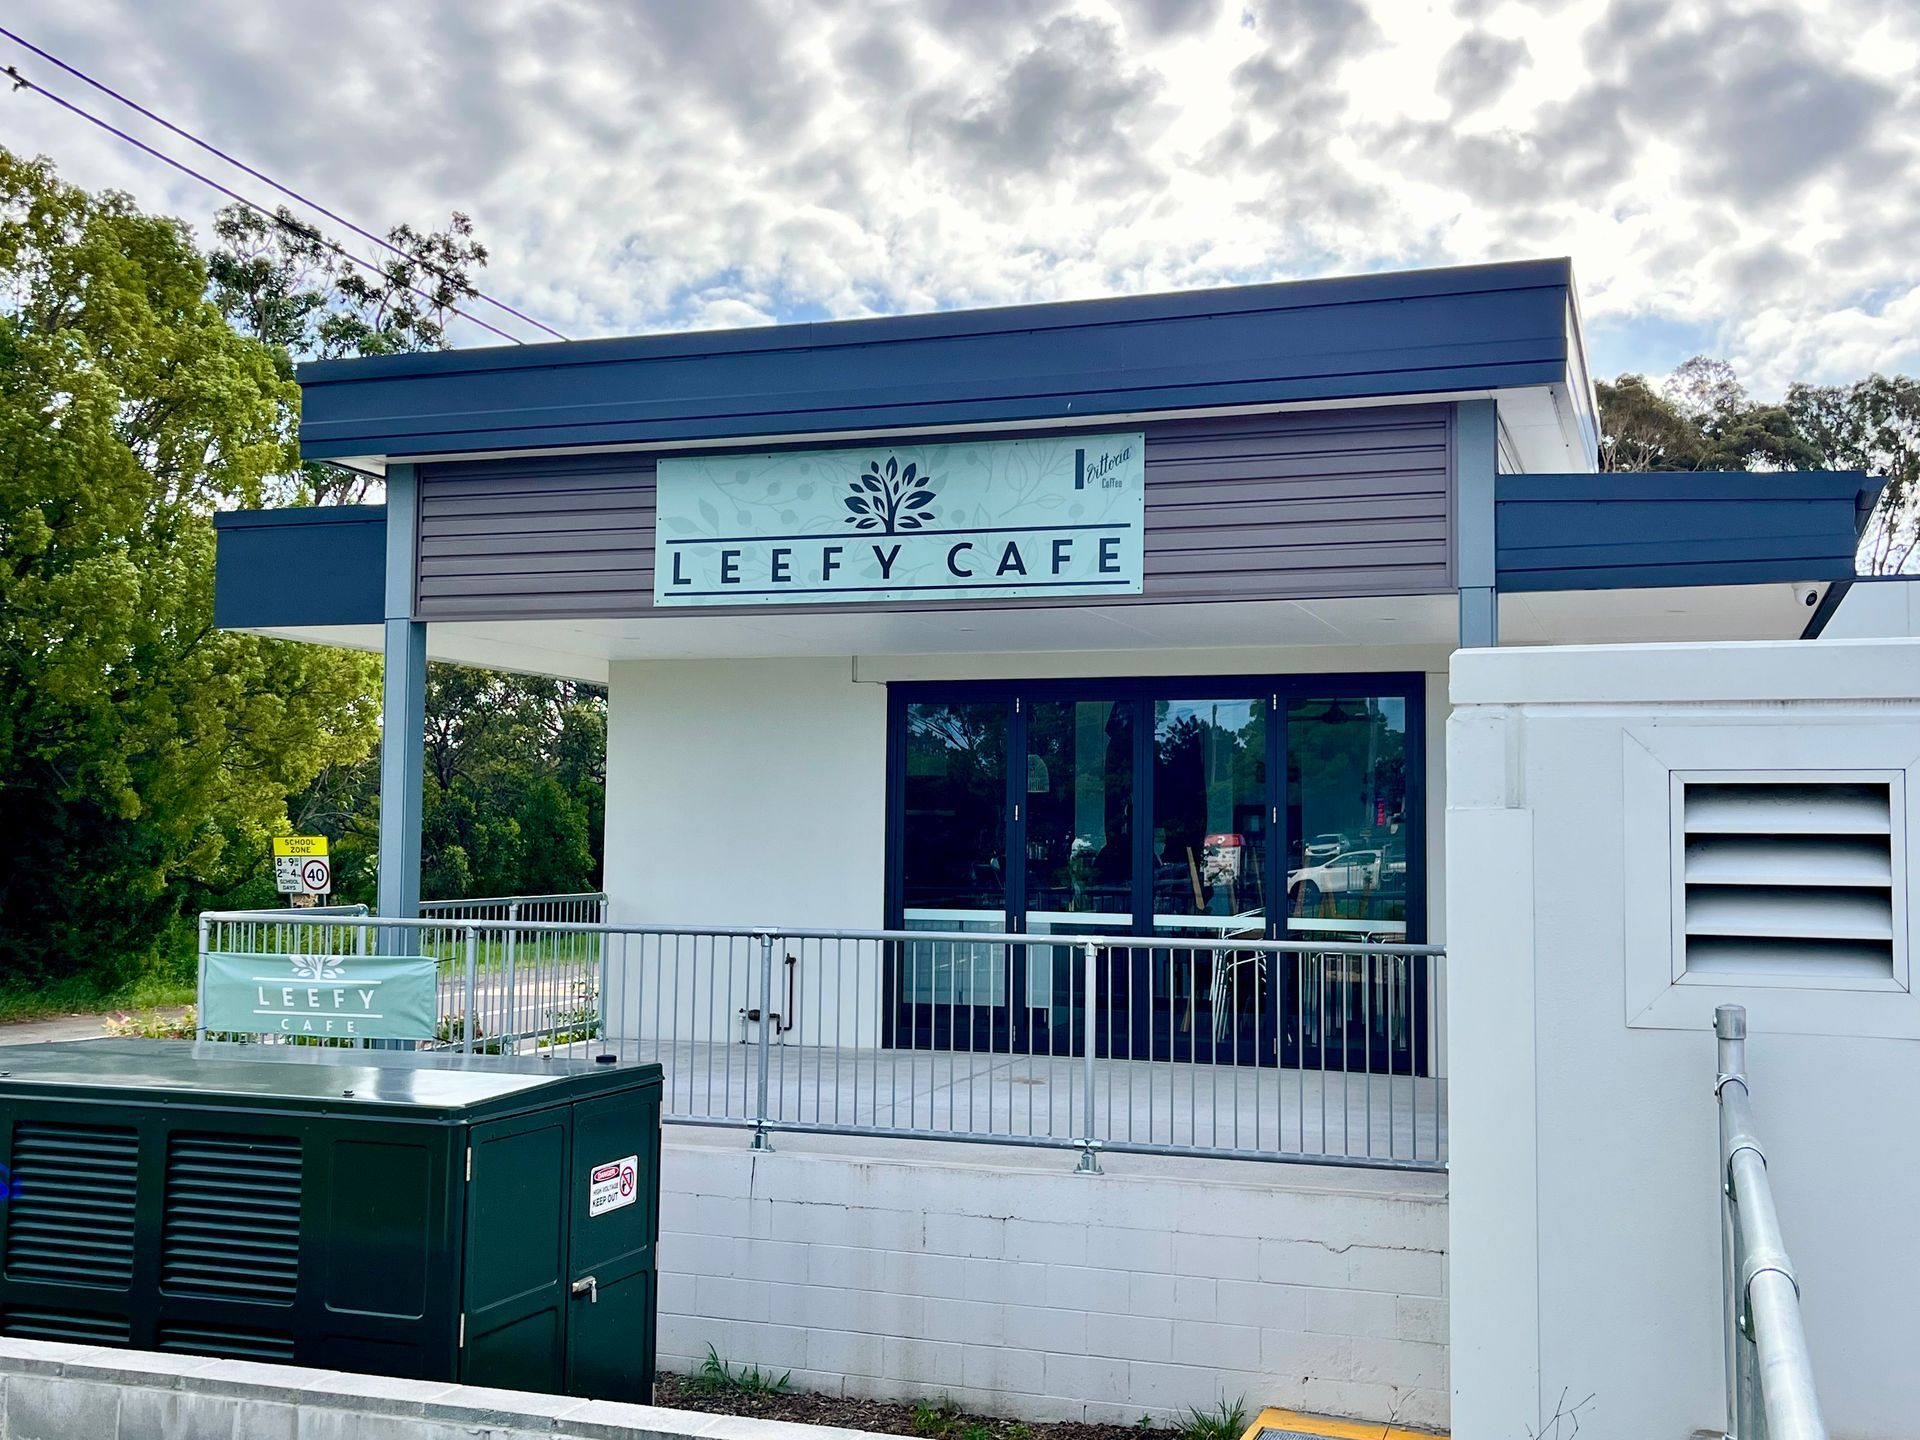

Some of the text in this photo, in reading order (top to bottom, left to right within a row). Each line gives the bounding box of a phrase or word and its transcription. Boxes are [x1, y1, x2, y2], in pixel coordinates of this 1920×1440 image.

[1086, 446, 1130, 484] Vittoria
[672, 537, 1122, 585] LEEFY CAFE
[277, 858, 282, 867] 8
[288, 858, 294, 867] 9
[277, 869, 282, 878] 2
[291, 869, 296, 877] 4
[307, 868, 324, 882] 40
[258, 986, 375, 1009] LEEFY
[280, 1018, 355, 1033] CAFE
[592, 1192, 619, 1208] KEEP OUT
